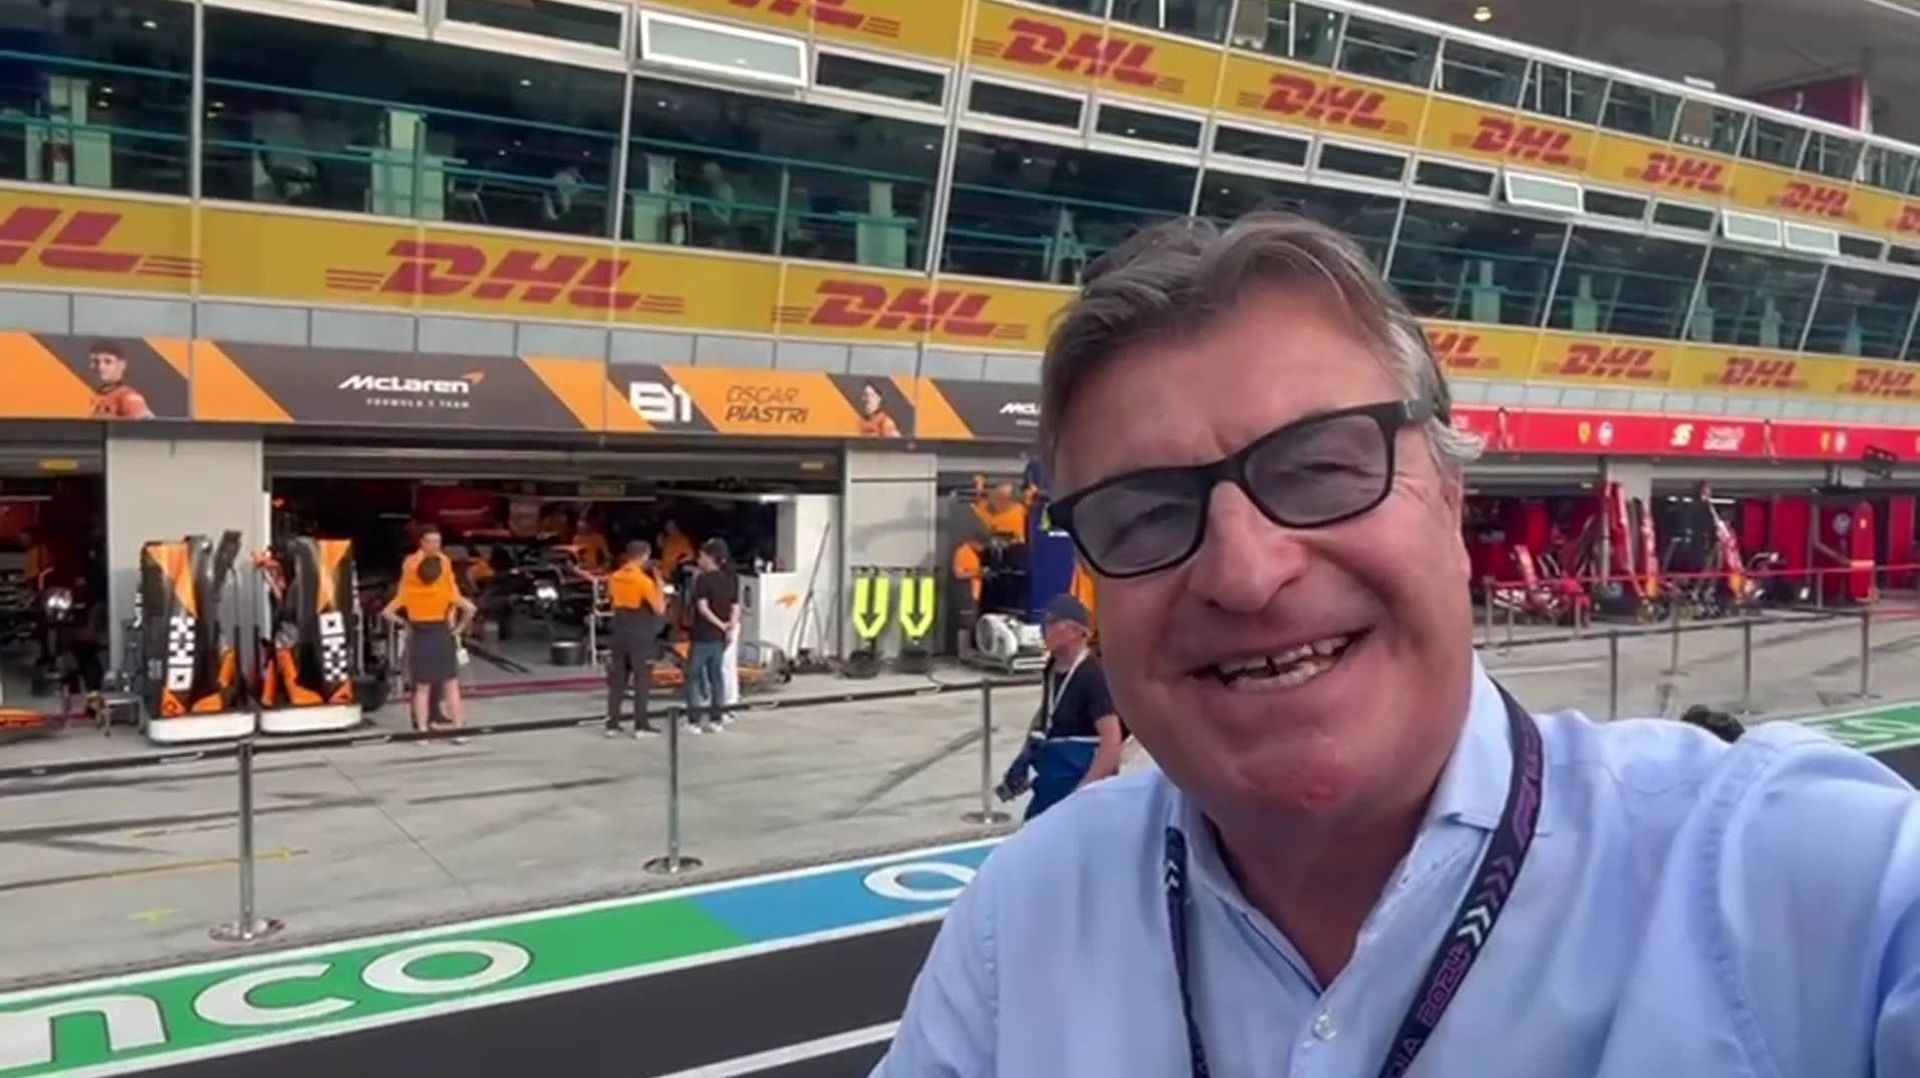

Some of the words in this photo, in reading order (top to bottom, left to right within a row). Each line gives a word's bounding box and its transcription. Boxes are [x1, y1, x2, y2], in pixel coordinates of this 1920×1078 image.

[1002, 18, 1157, 86] DHL
[1262, 74, 1386, 130] DHL
[1471, 116, 1571, 165] DHL
[1641, 151, 1724, 194] DHL
[1780, 181, 1849, 217] DHL
[0, 206, 142, 273] HL
[381, 240, 642, 310] DHL
[809, 279, 998, 337] DHL
[1427, 332, 1480, 368] HL
[1559, 343, 1654, 379] DHL
[338, 374, 469, 394] McLaren
[1720, 357, 1798, 389] DHL
[1850, 368, 1916, 396] DHL
[629, 381, 692, 423] 81
[725, 404, 810, 423] PIASTRI
[726, 385, 799, 405] OSCAR
[1416, 942, 1472, 1028] 2024
